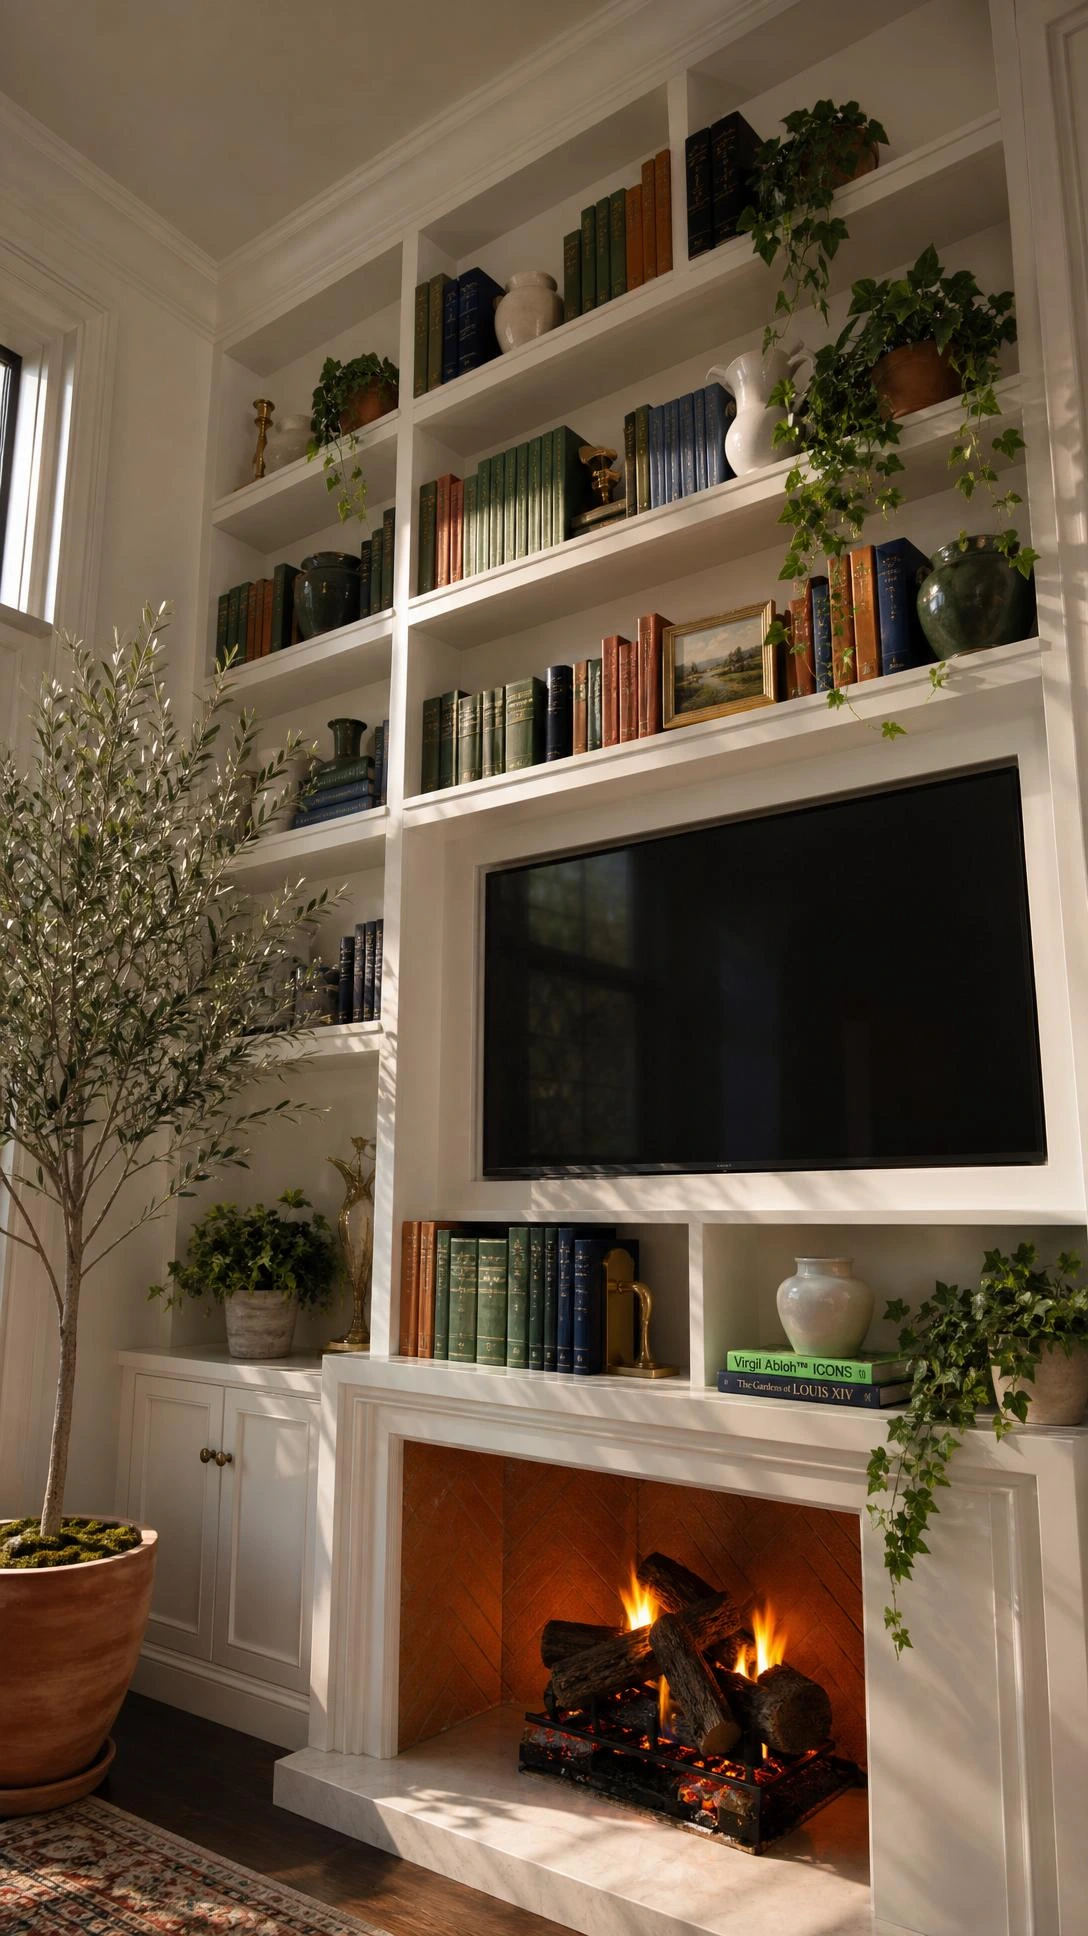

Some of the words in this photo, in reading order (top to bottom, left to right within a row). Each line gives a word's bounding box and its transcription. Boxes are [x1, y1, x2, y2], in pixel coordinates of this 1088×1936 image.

[734, 1356, 761, 1372] Virgil
[813, 1363, 853, 1378] ICONS
[737, 1379, 752, 1389] The
[752, 1380, 782, 1392] Gardens
[783, 1383, 791, 1393] of
[793, 1383, 829, 1398] LOUIS
[832, 1387, 854, 1400] XIV
